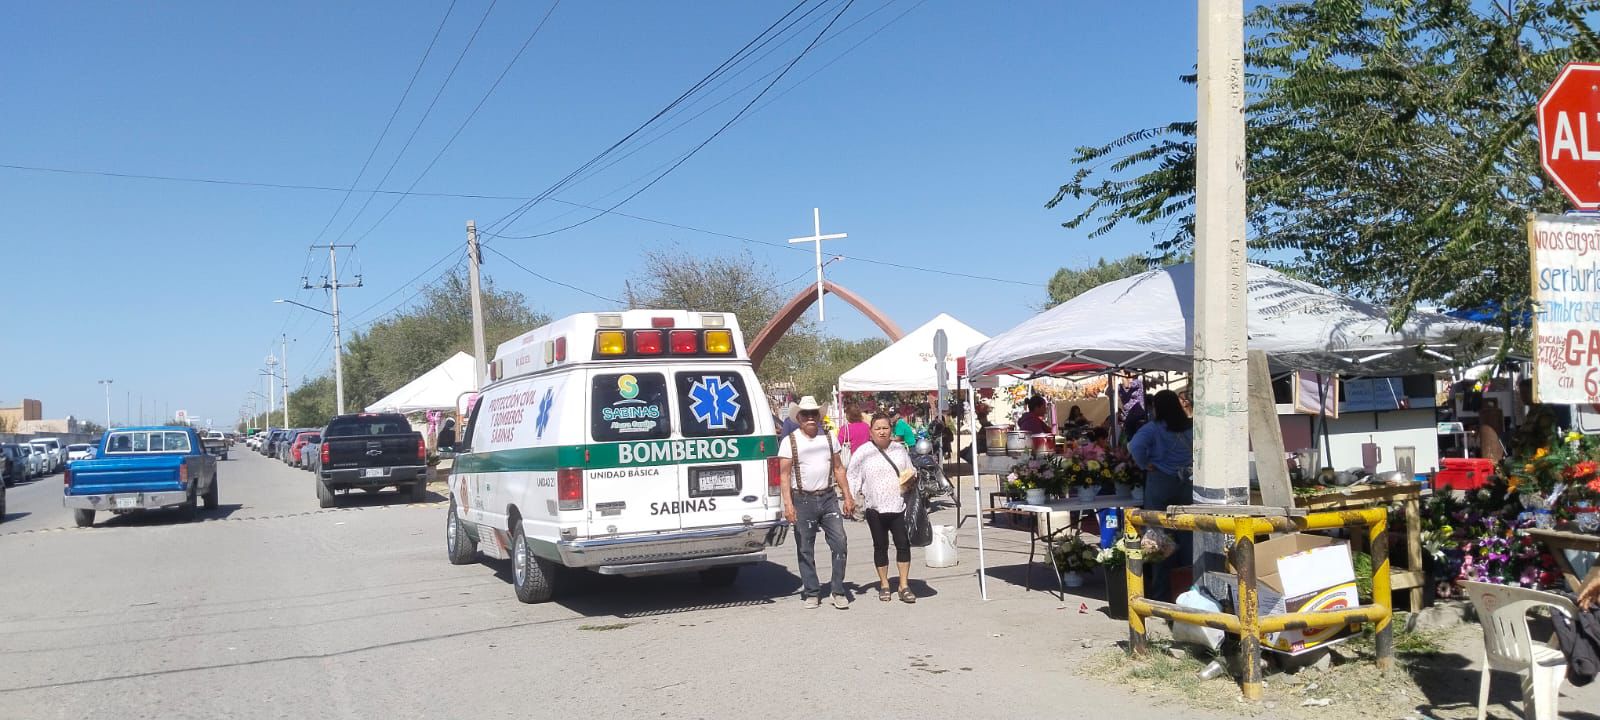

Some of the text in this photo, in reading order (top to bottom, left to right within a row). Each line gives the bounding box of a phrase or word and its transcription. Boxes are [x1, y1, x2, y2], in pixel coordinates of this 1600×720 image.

[1551, 111, 1600, 160] AL
[602, 405, 660, 420] SABINAS
[618, 438, 740, 464] BOMBEROS
[590, 466, 660, 479] UNIDAD BÁSICA
[650, 497, 717, 516] SABINAS
